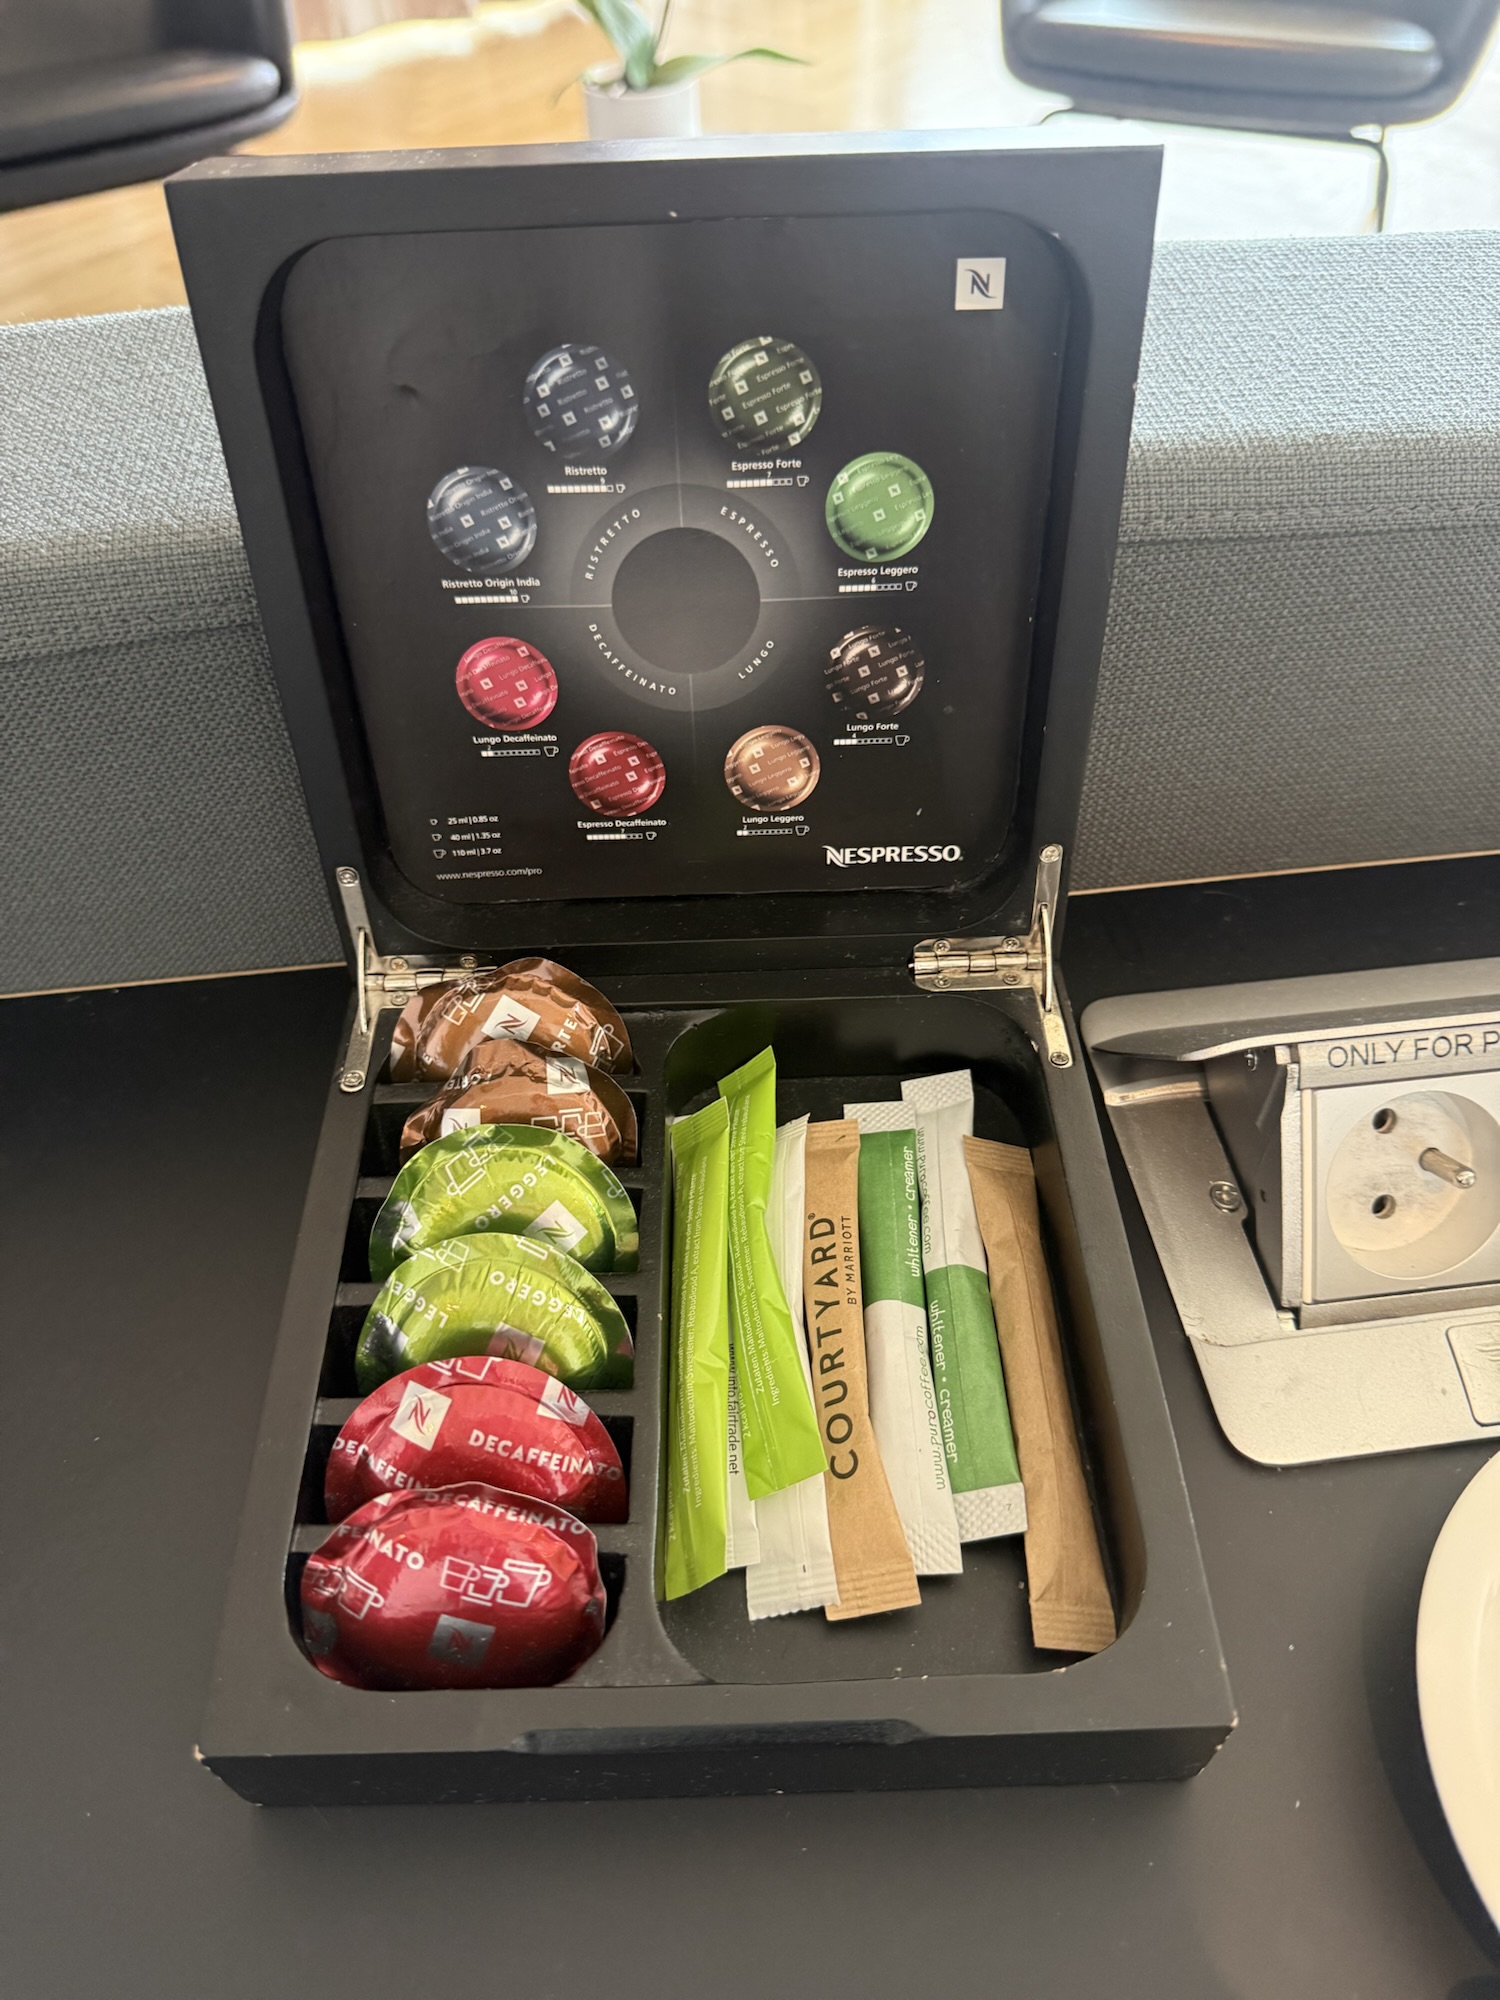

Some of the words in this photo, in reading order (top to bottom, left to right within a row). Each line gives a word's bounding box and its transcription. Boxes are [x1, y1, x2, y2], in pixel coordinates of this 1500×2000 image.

[742, 392, 771, 409] Espresso
[772, 383, 791, 395] Forte
[565, 466, 607, 476] Ristretto
[732, 461, 774, 472] Espresso
[776, 459, 801, 468] Forte
[585, 509, 640, 580] RISTRETTO
[720, 506, 779, 567] ESPRESSO
[442, 579, 483, 589] Ristretto
[485, 579, 515, 589] Origin
[516, 577, 540, 586] India
[838, 568, 877, 578] Espresso
[880, 566, 918, 576] Leggero
[589, 624, 676, 695] DECAFFEINATO
[738, 640, 774, 679] LUNGO
[878, 656, 898, 668] Lungo
[870, 676, 888, 686] Forte
[473, 736, 501, 745] Lungo
[503, 734, 557, 743] Decaffeinato
[846, 724, 874, 732] Lungo
[876, 722, 899, 731] Forte
[578, 821, 613, 829] Espresso
[615, 819, 667, 828] Decaffeinato
[742, 816, 768, 824] Lungo
[770, 815, 804, 823] Leggero
[436, 868, 542, 880] www.nespresso.com/pro
[822, 845, 961, 868] NESPRESSO
[1328, 1040, 1404, 1068] ONLY
[1414, 1033, 1473, 1060] FOR
[475, 1154, 557, 1229] LEGGERO
[903, 1146, 915, 1201] creamer
[692, 1239, 700, 1264] extract
[743, 1242, 755, 1289] Sweetener:
[841, 1215, 857, 1285] MARRIOTT
[905, 1213, 920, 1278] whitener
[489, 1270, 586, 1323] LEGGERO
[686, 1276, 697, 1327] Rebaudiosid
[847, 1289, 858, 1305] BY
[740, 1295, 756, 1355] Maltodextrin,
[749, 1289, 766, 1348] Maltodextrin,
[685, 1329, 695, 1379] Sweetener:
[750, 1353, 765, 1394] Zutaten:
[761, 1349, 780, 1406] Ingredients:
[929, 1300, 946, 1371] whitener
[940, 1388, 958, 1463] creamer
[686, 1381, 697, 1445] Maltodextrin,
[740, 1410, 749, 1431] kcal
[915, 1325, 946, 1490] www.purocoffee.com
[469, 1428, 622, 1482] DECAFFEINATO
[743, 1431, 751, 1439] 2
[691, 1446, 702, 1507] Ingredients:
[425, 1492, 588, 1536] DECAFFEINATO
